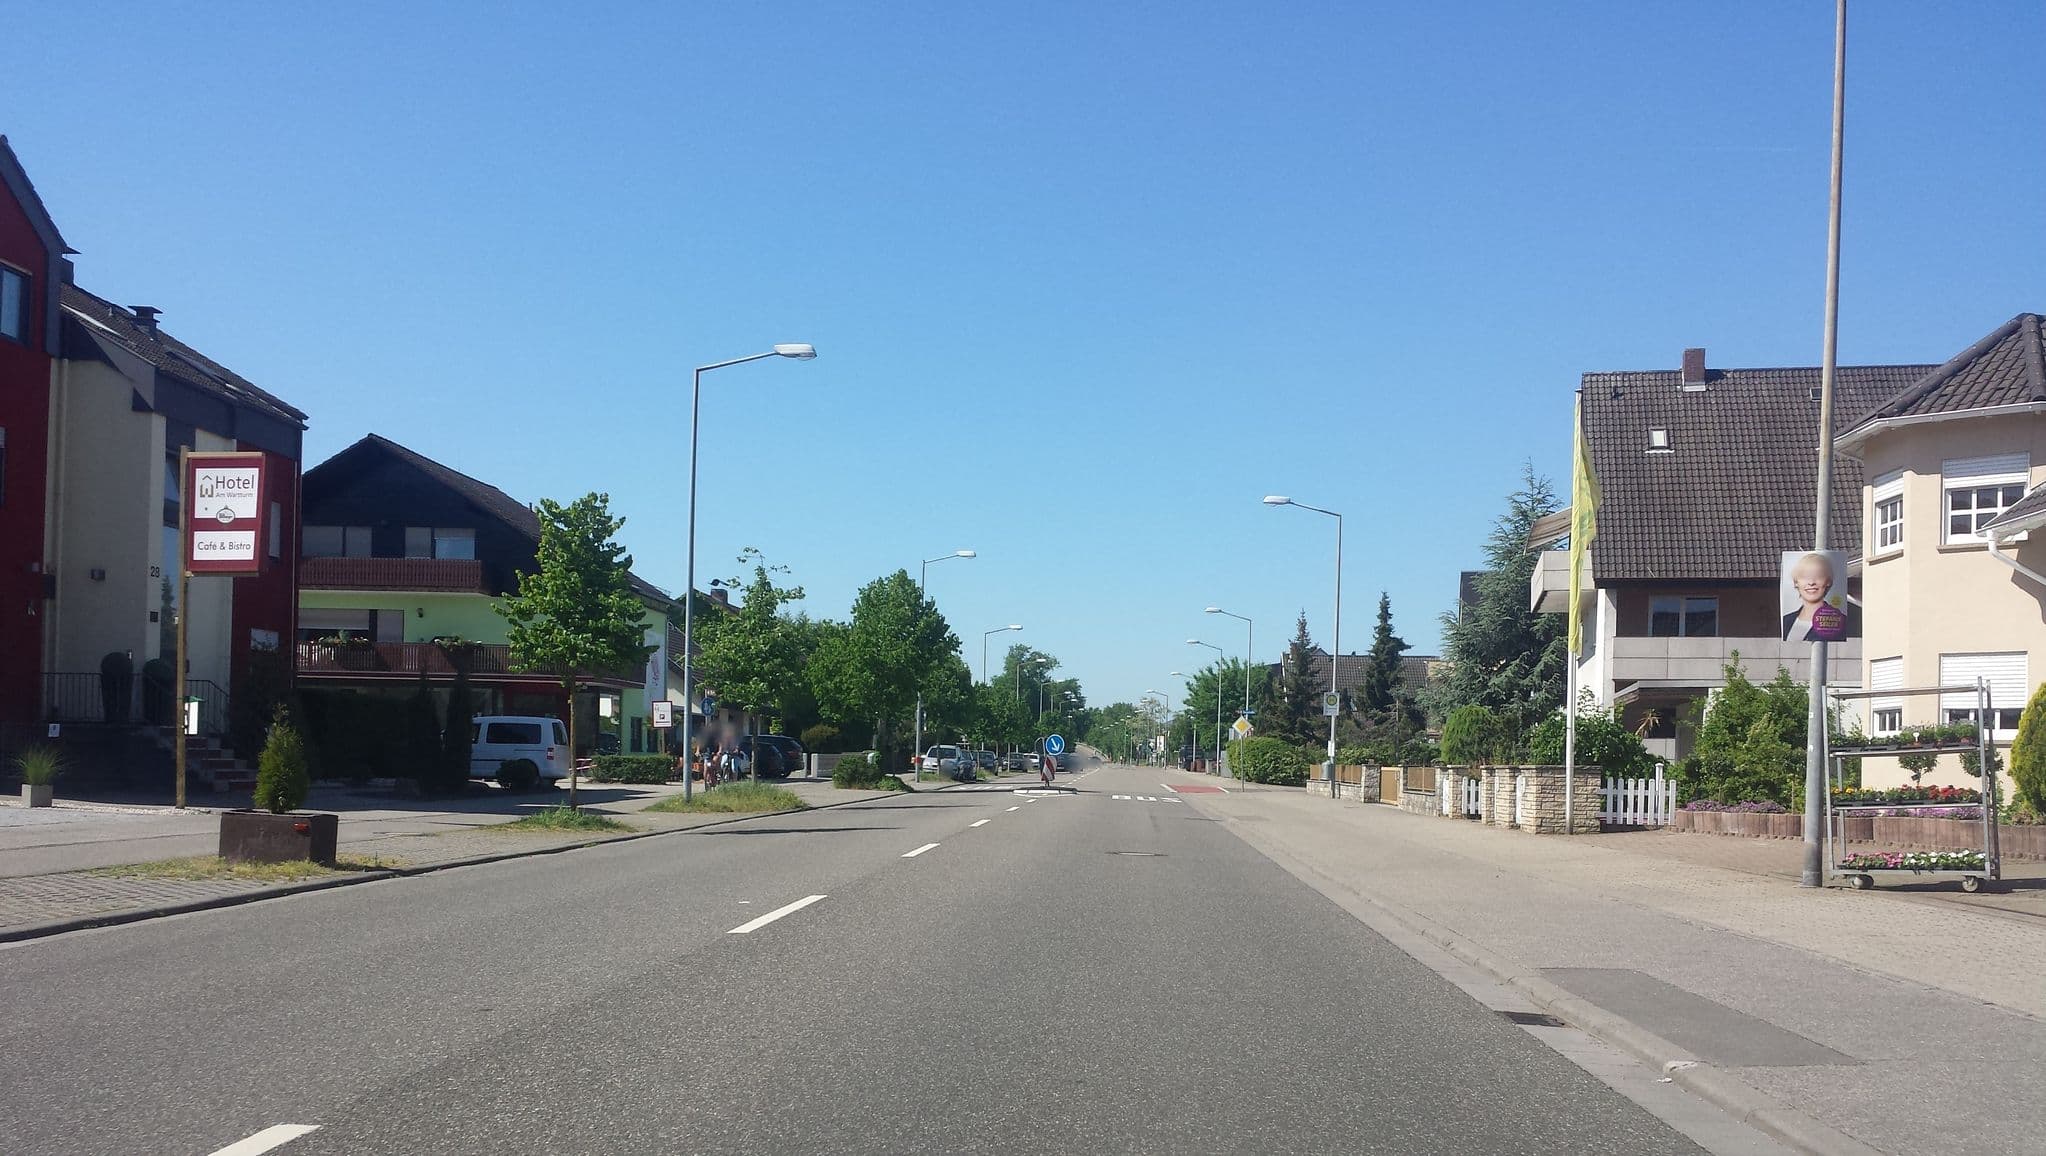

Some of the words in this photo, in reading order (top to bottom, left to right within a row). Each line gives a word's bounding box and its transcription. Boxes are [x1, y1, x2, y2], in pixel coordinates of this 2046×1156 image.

[215, 474, 254, 490] Hotel
[197, 541, 217, 551] Café
[219, 541, 226, 551] &
[228, 540, 251, 551] Bistro
[150, 565, 160, 578] 28
